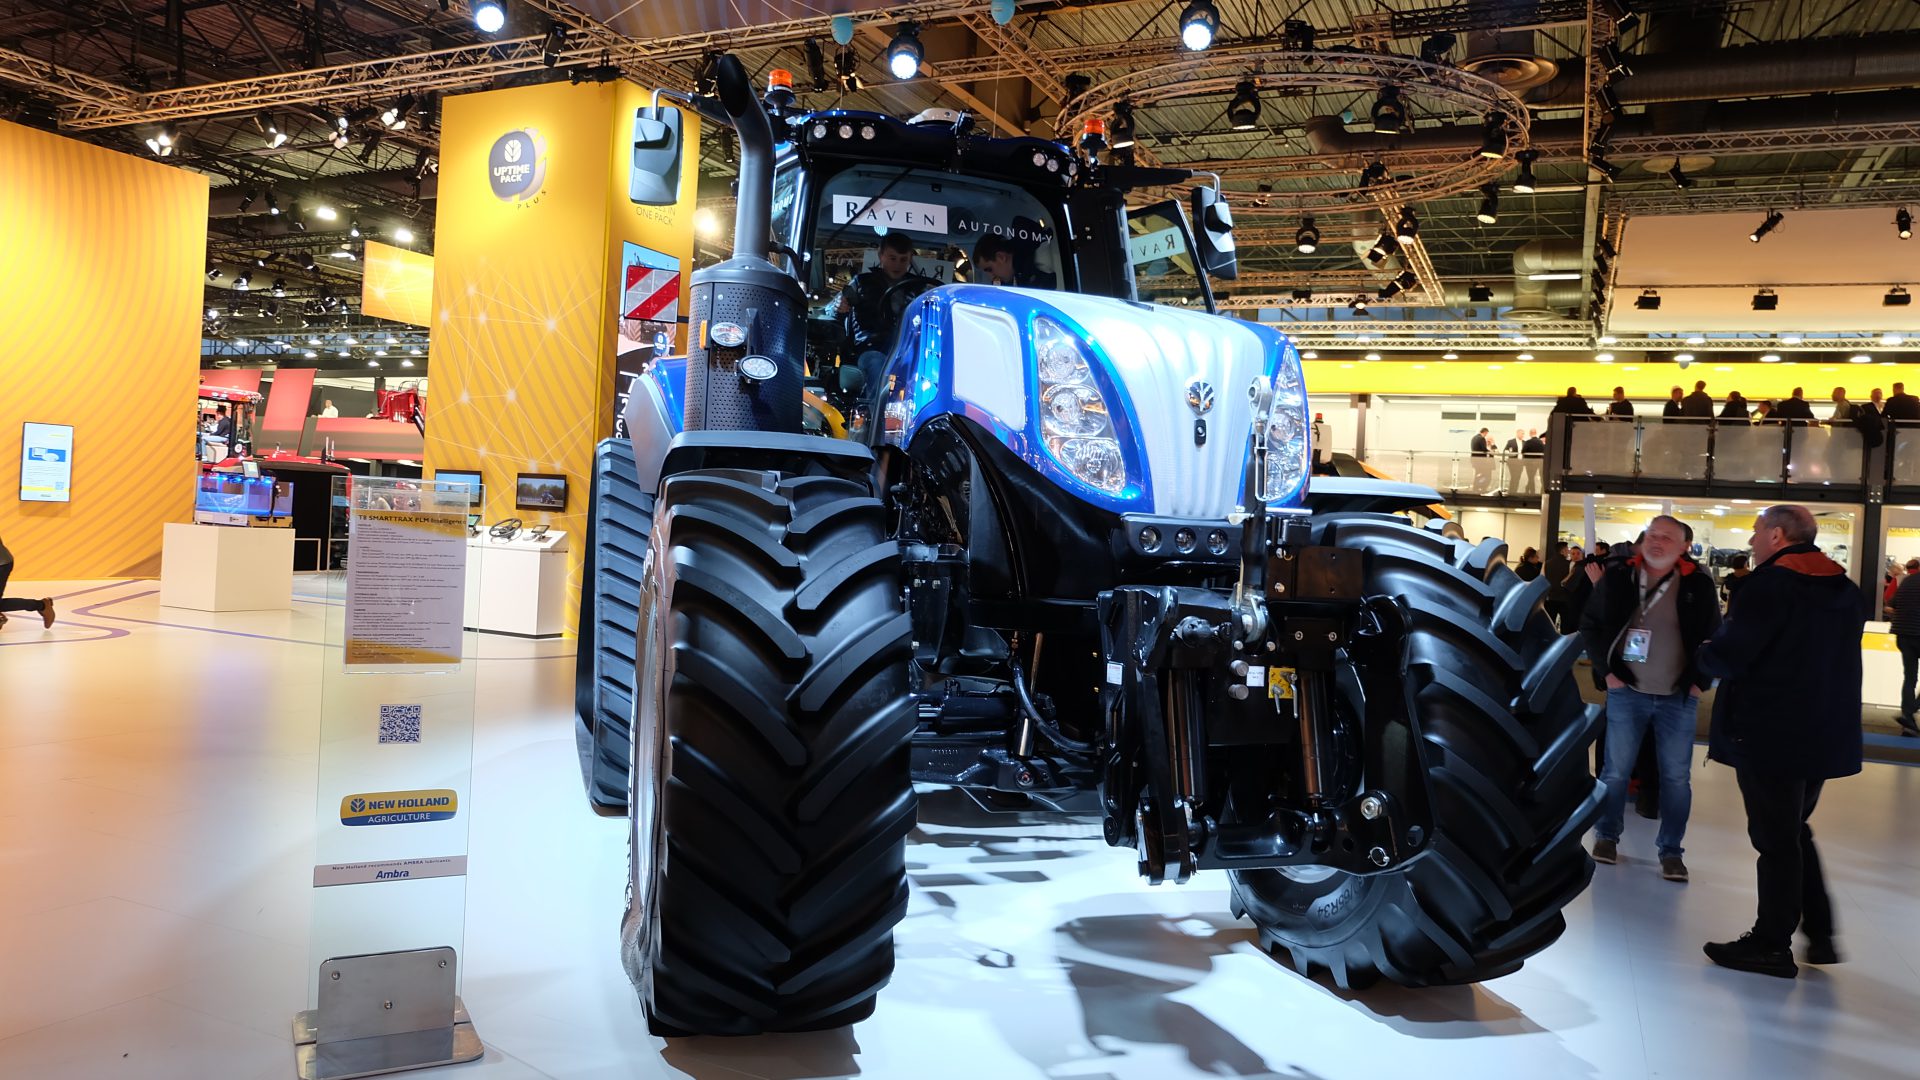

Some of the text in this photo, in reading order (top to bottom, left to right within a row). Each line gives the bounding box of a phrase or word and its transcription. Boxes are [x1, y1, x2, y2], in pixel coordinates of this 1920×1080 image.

[494, 164, 530, 176] UPTIME
[500, 174, 522, 183] PACK
[517, 189, 547, 210] PLUS
[636, 206, 652, 220] ONE
[655, 213, 672, 226] PACK
[846, 202, 1053, 244] RAVEN AUTONOMY
[369, 797, 450, 810] NEW HOLLAND
[368, 813, 431, 823] AGRICULTURE
[376, 870, 409, 879] Ambra
